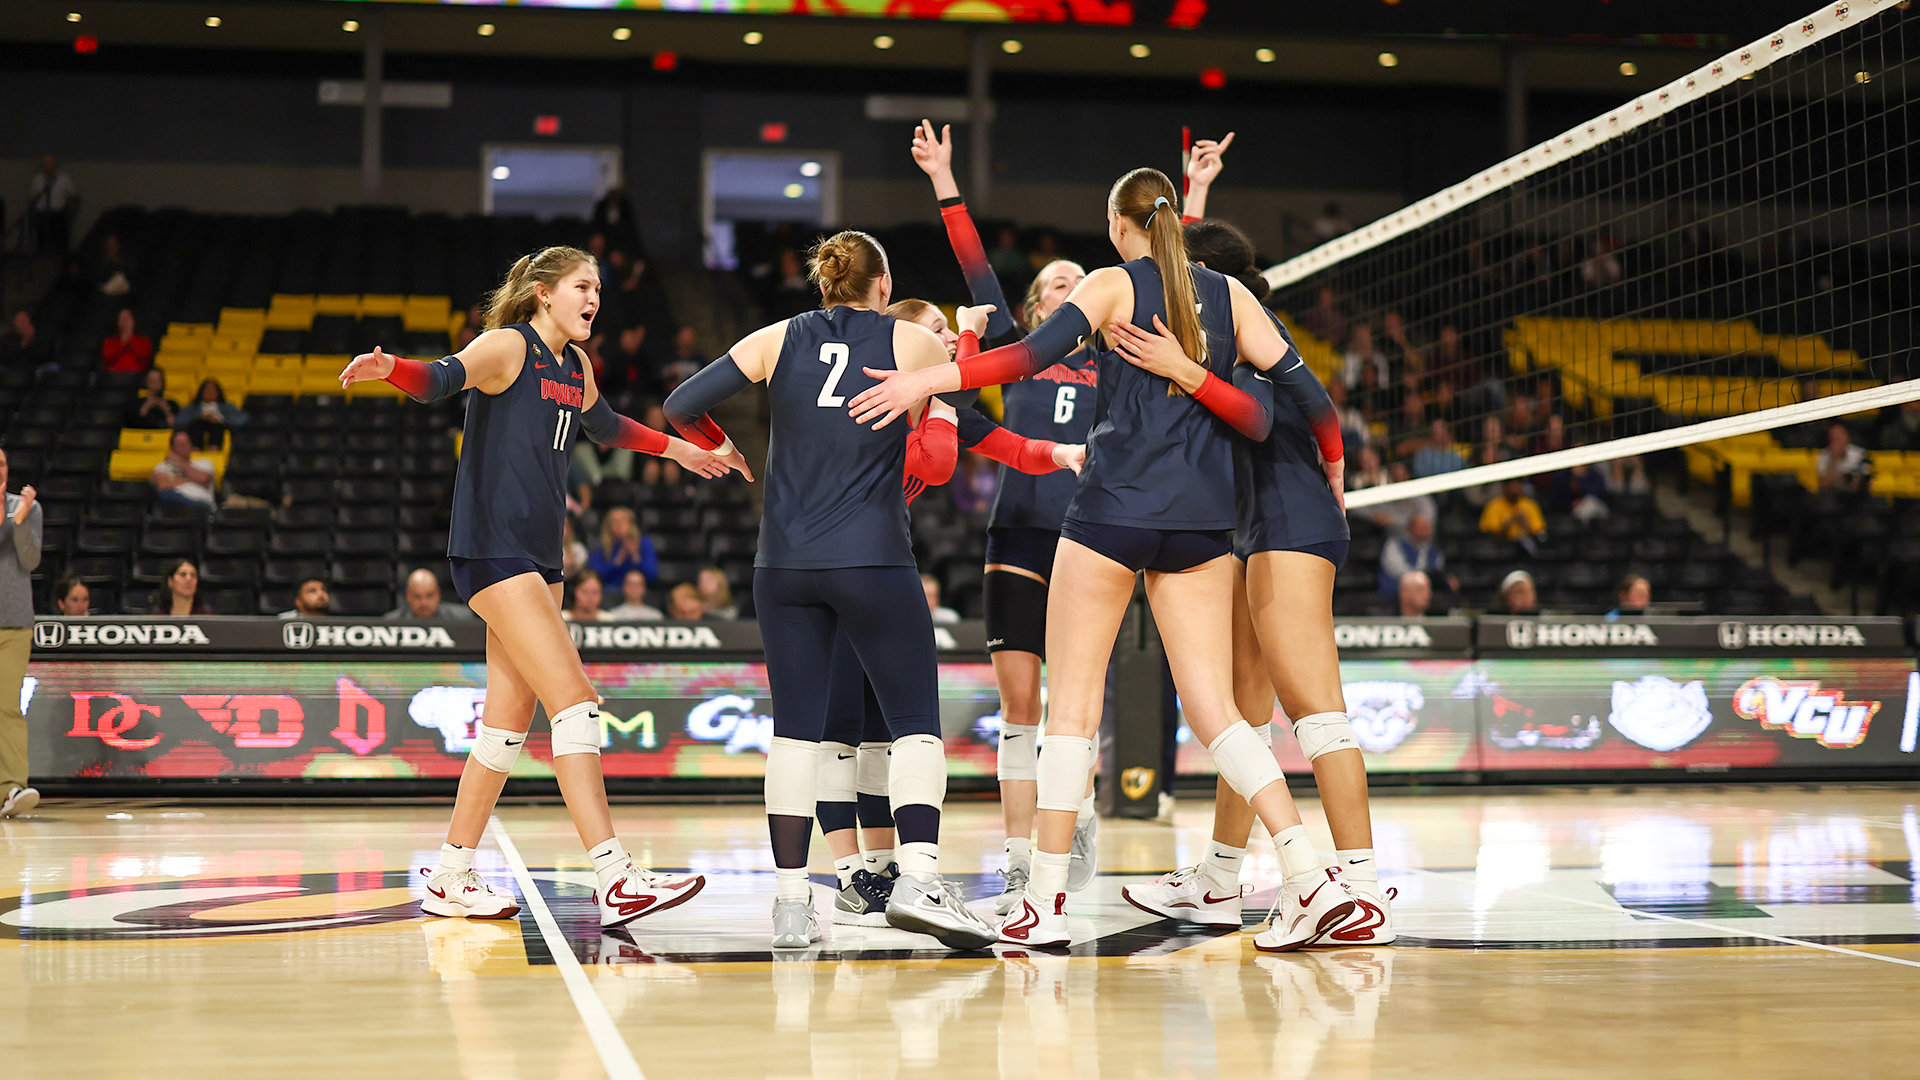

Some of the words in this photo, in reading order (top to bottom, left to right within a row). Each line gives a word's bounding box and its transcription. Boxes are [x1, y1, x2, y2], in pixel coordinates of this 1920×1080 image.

[817, 342, 850, 408] 2
[1032, 363, 1098, 388] UQUESN
[541, 377, 583, 409] DUQUESN
[1053, 385, 1077, 424] 6
[553, 408, 573, 451] 11
[67, 624, 210, 645] HONDA
[316, 625, 456, 647] HONDA
[583, 625, 722, 648] HONDA
[1334, 623, 1432, 648] ONDA
[1536, 623, 1659, 646] HONDA
[1748, 624, 1866, 647] HONDA
[1755, 680, 1878, 747] VCU
